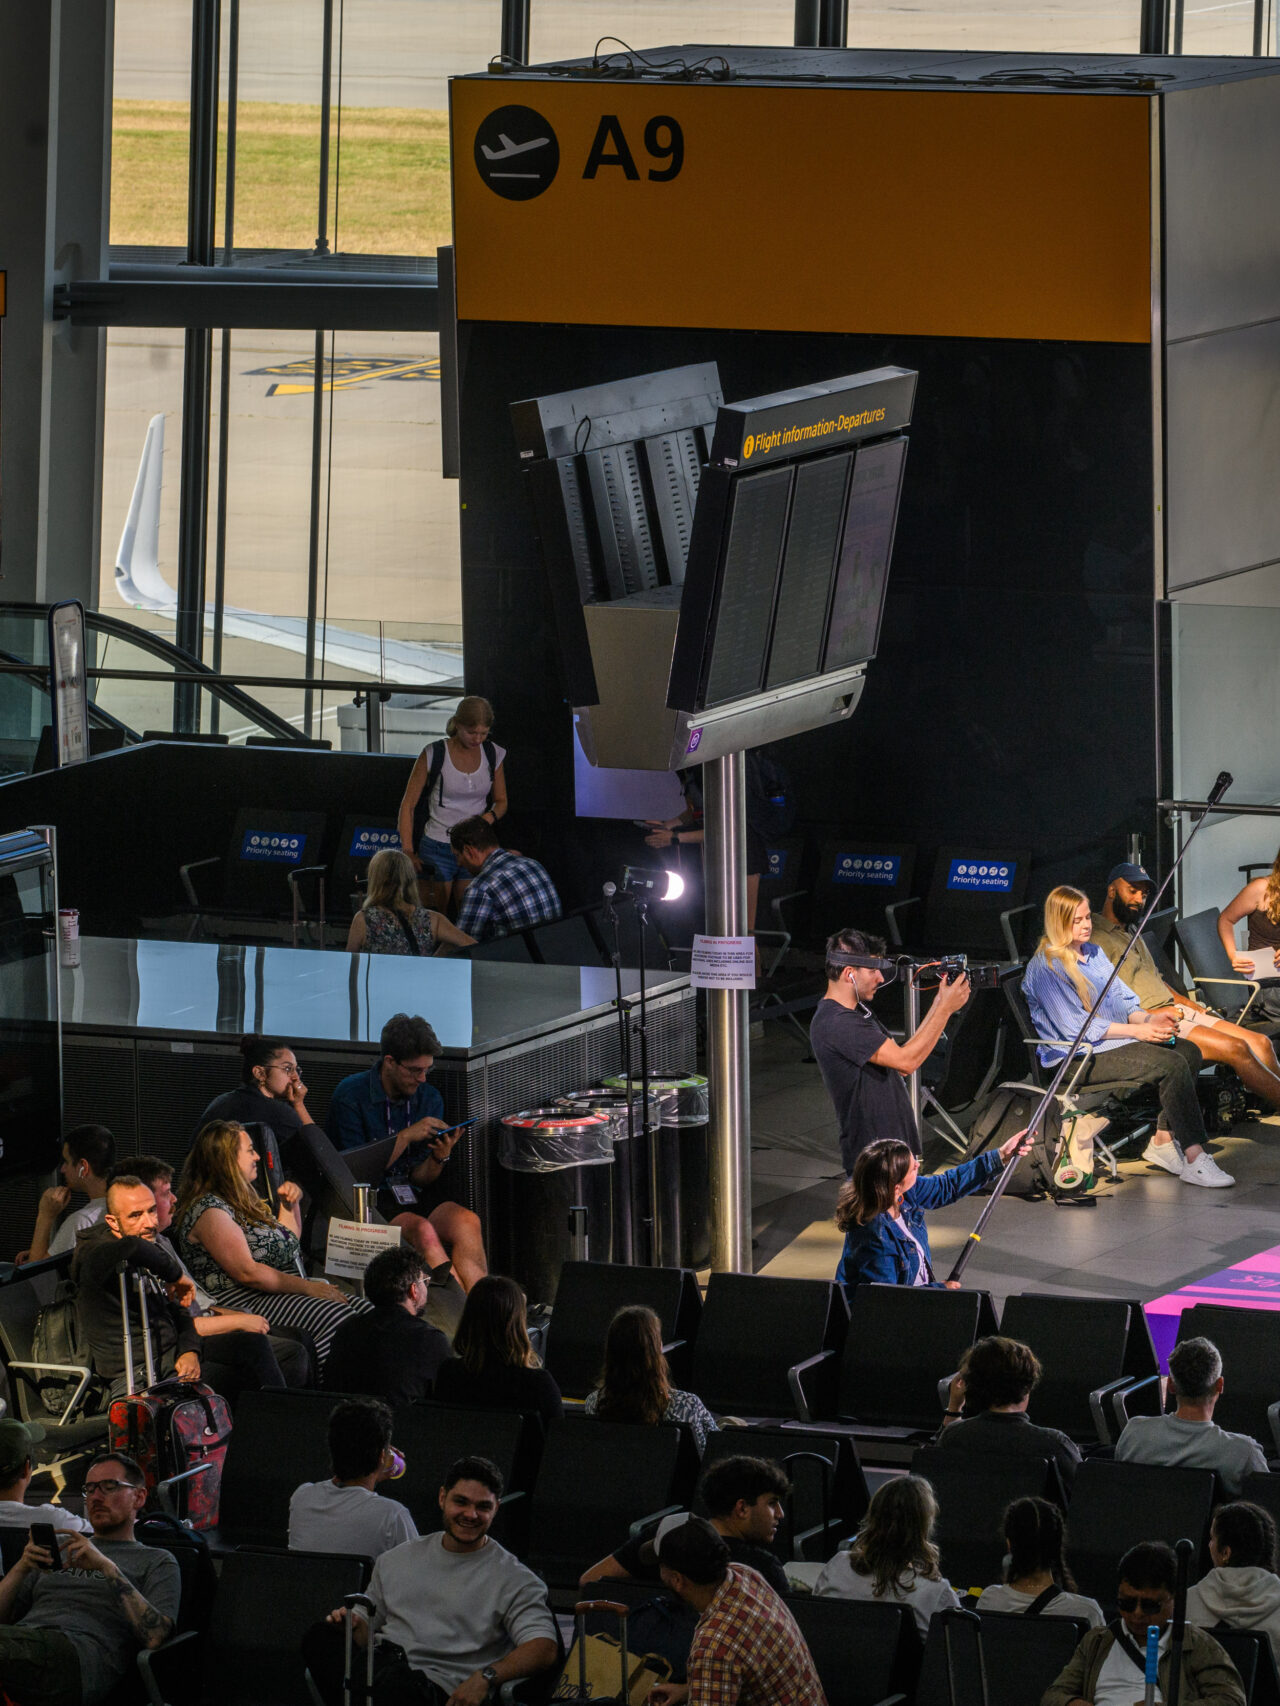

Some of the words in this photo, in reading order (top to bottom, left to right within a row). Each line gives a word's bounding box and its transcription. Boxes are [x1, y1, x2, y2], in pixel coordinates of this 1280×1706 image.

[582, 115, 685, 182] A9
[755, 428, 782, 454] Flight
[245, 846, 272, 857] Priority
[272, 848, 299, 859] seating
[837, 869, 865, 879] Priority
[866, 871, 893, 881] seating
[952, 875, 980, 886] Priority
[981, 877, 1009, 887] seating
